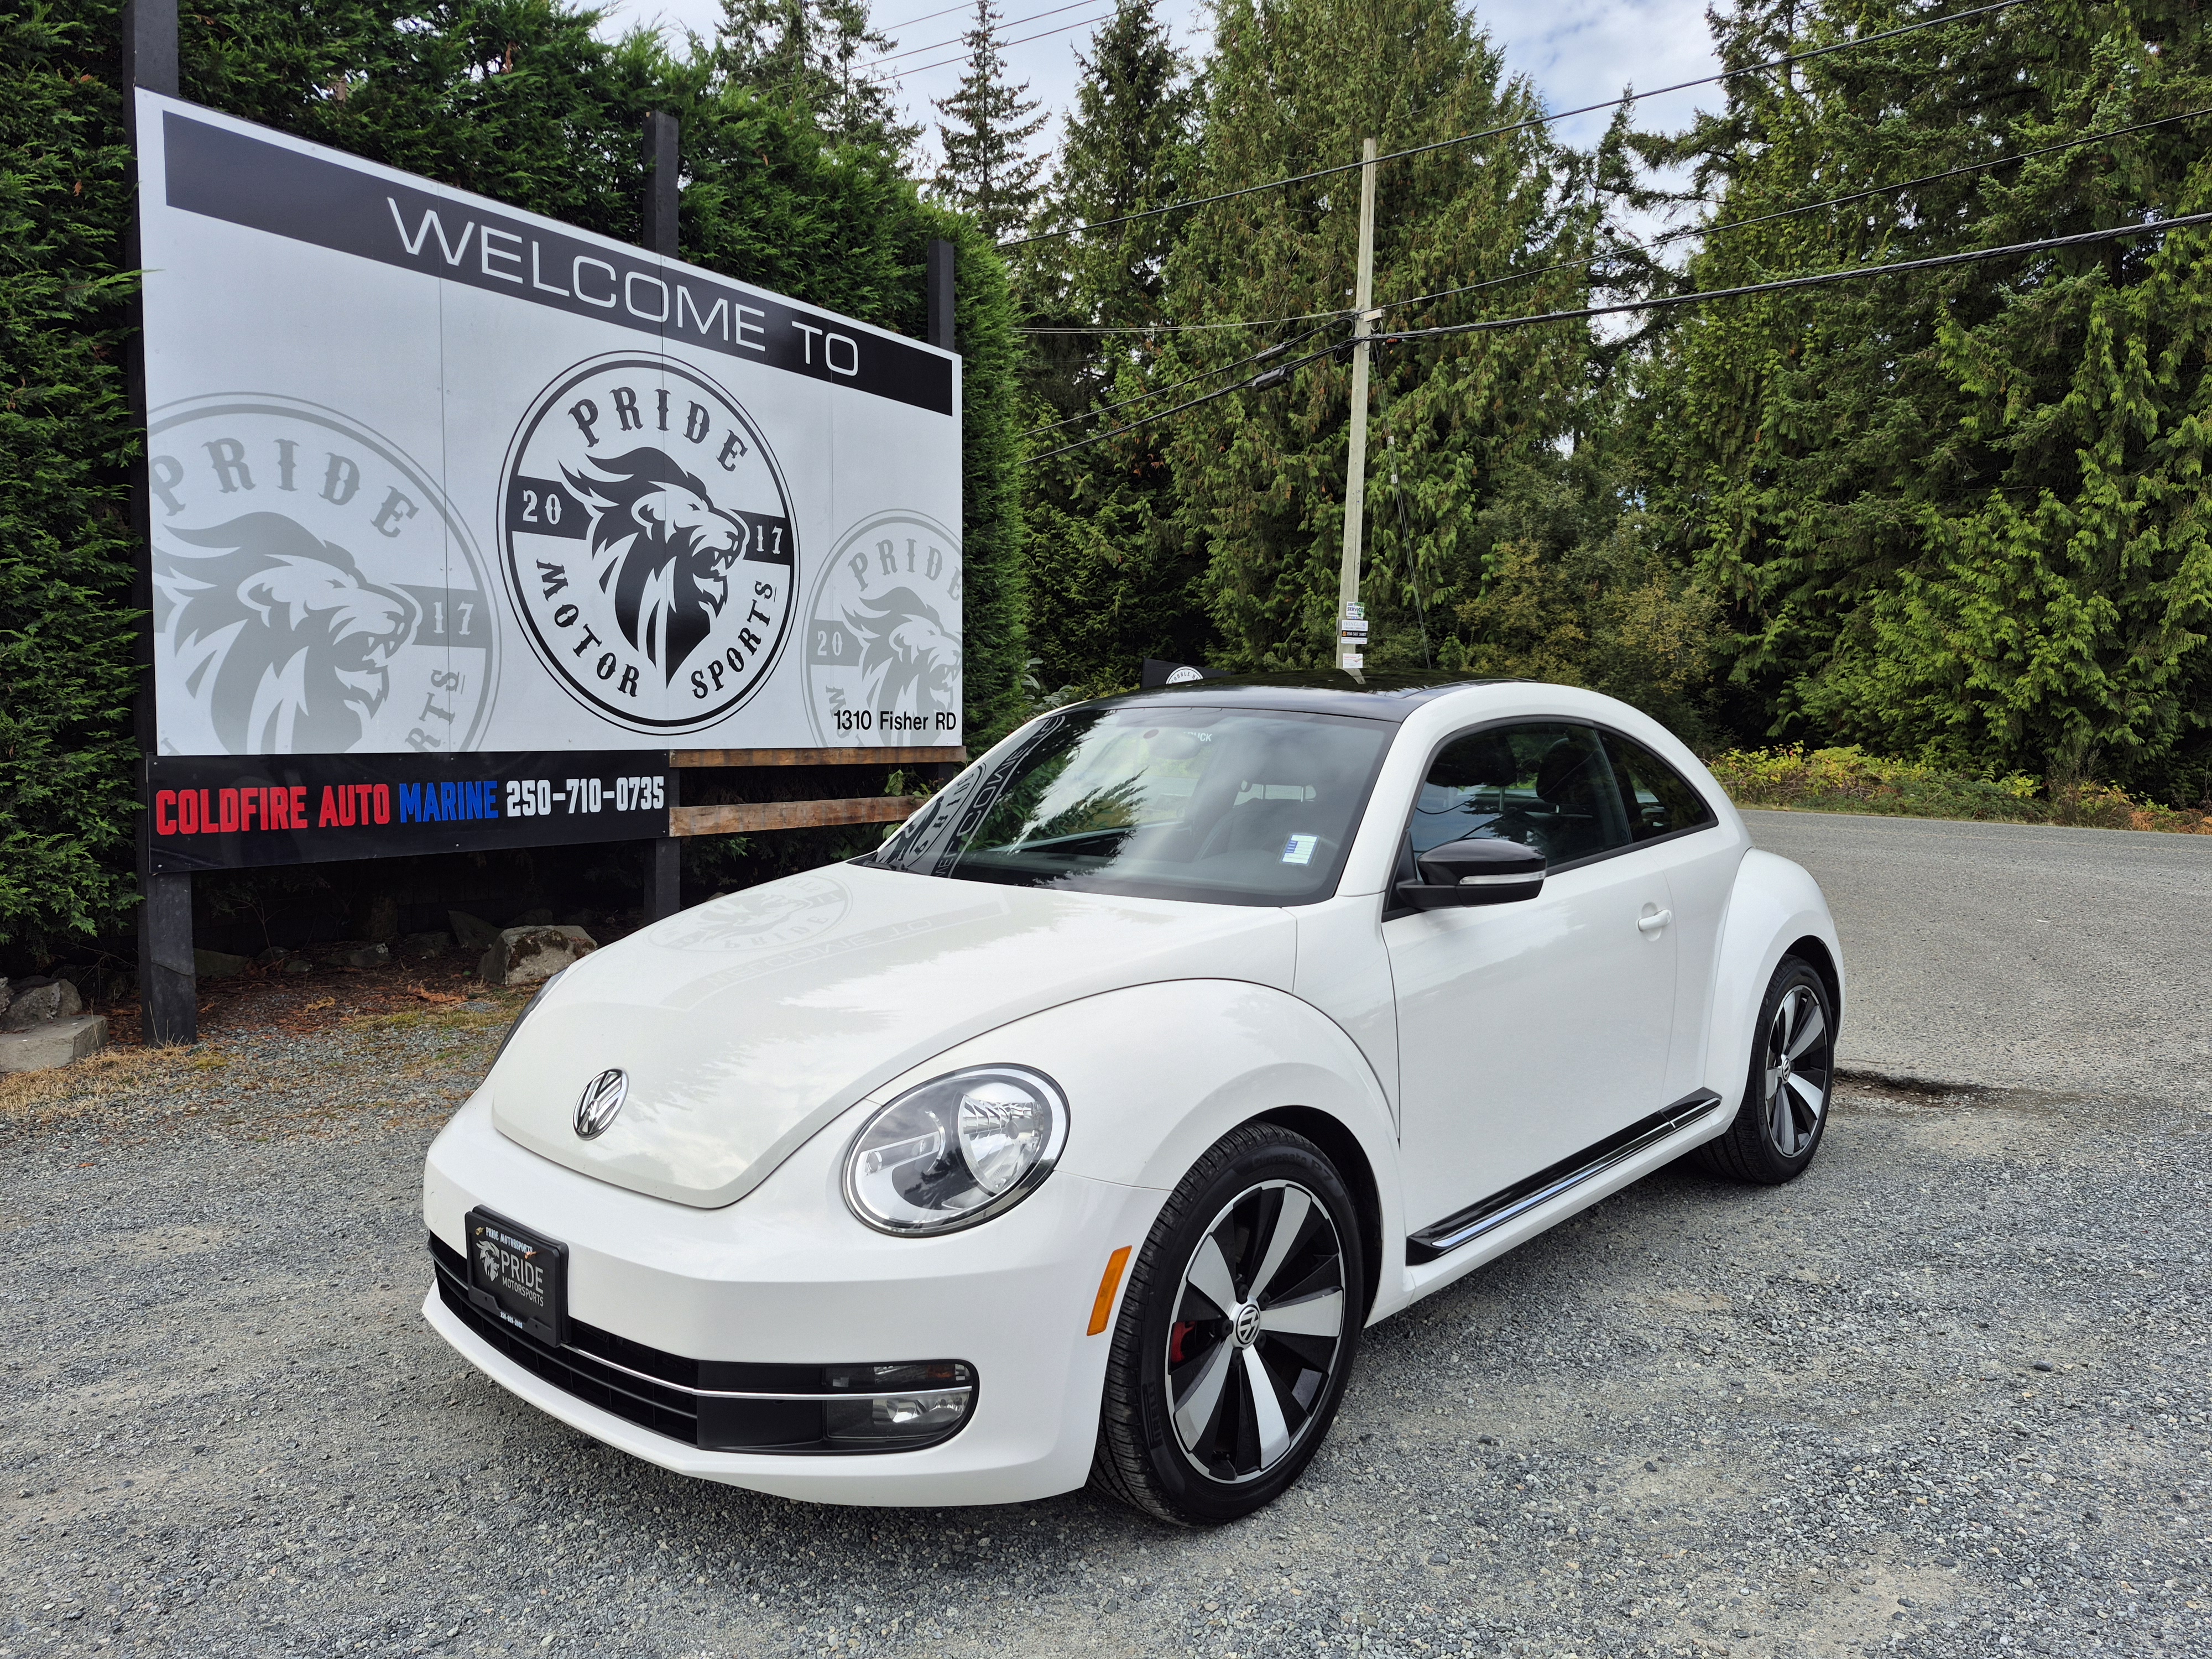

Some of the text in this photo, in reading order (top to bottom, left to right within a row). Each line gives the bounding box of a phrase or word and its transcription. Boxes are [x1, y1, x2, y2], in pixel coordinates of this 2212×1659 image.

[387, 197, 859, 377] WELCOME TO
[568, 386, 749, 472] PRIDE
[149, 437, 420, 538] PRIDE
[523, 489, 783, 555] 20 17
[847, 538, 962, 601] PRIDE
[433, 601, 474, 636] 17
[535, 558, 774, 700] MOTOR SPORTS
[817, 630, 843, 656] 20
[404, 669, 460, 752] RTS
[833, 709, 956, 731] 1310 Fisher RD
[155, 775, 665, 836] COLDFIRE AUTO MARINE 250-710-0735
[486, 1227, 534, 1254] PRIDE MOTORSPORTS
[500, 1249, 544, 1295] PRIDE
[502, 1275, 544, 1307] MOTORSPORTS
